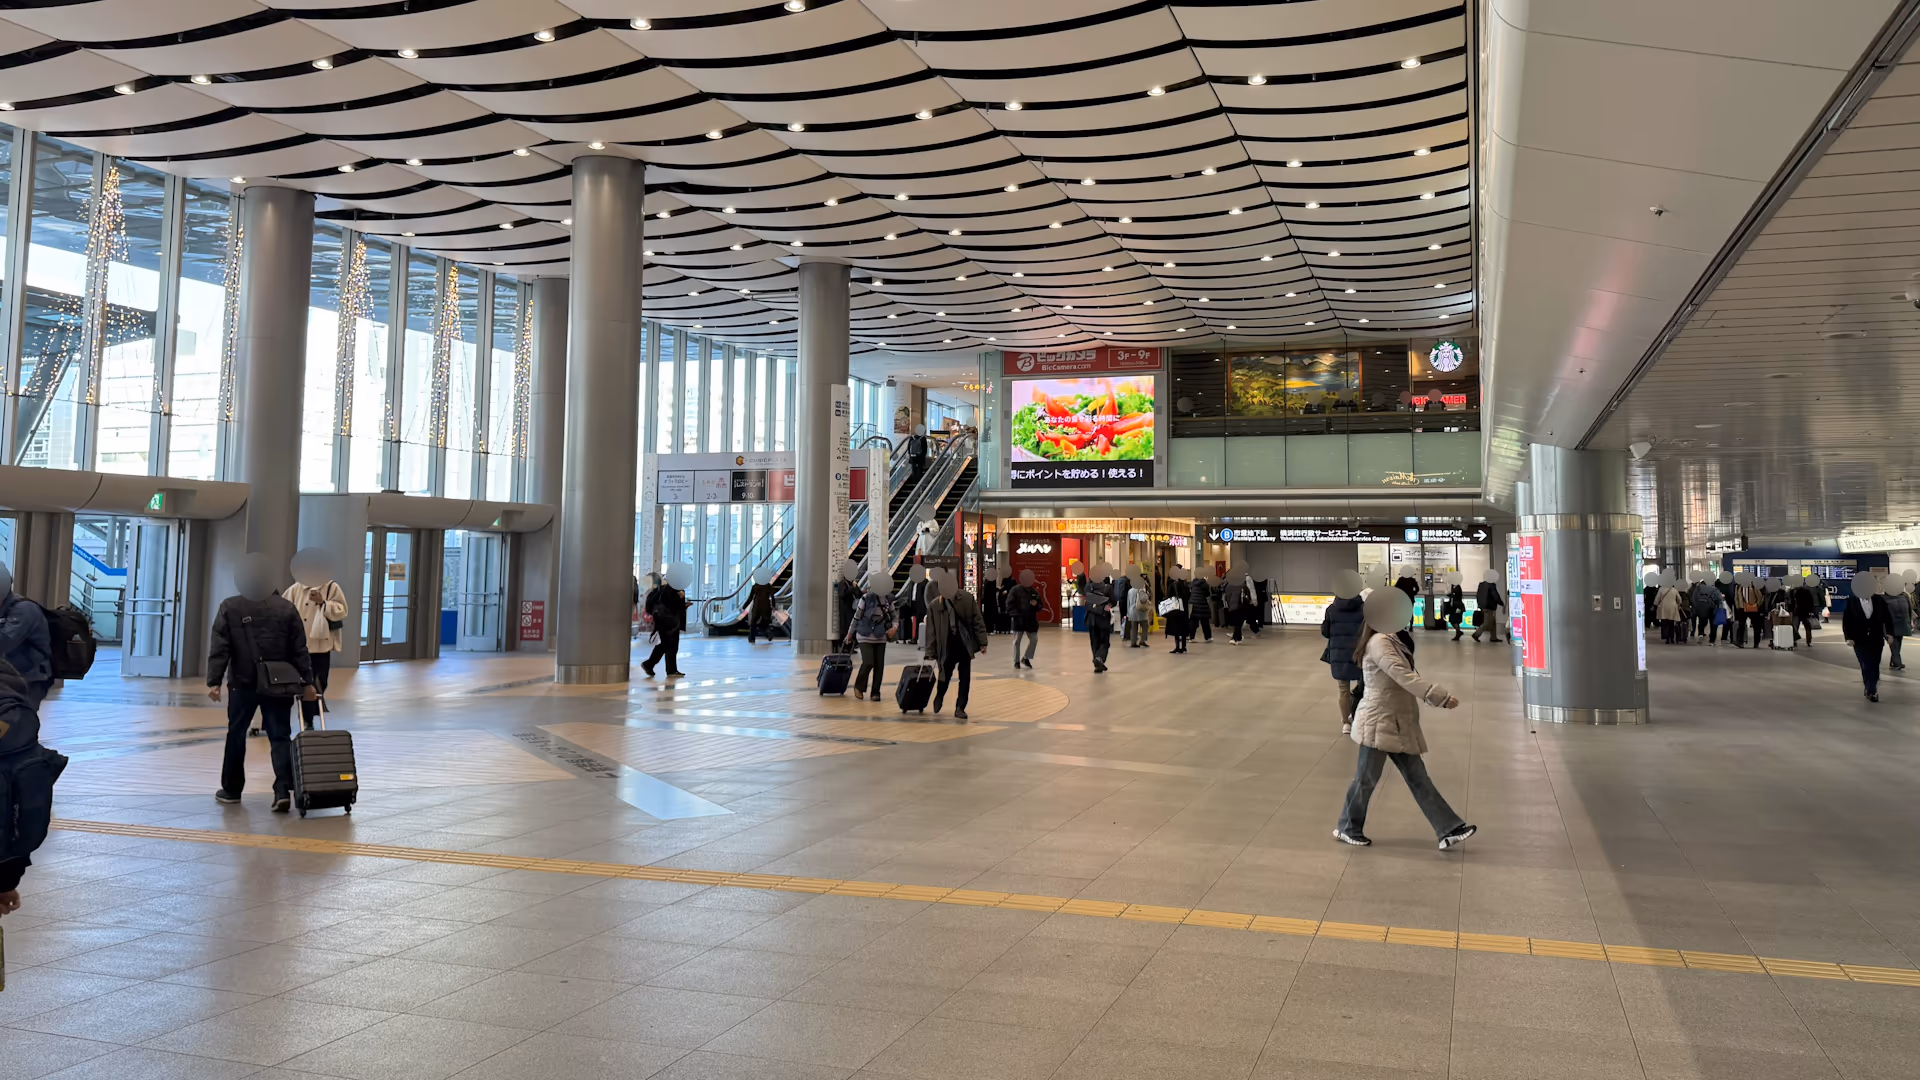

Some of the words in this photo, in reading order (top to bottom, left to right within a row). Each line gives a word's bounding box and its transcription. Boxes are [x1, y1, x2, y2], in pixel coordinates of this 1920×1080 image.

[1036, 349, 1096, 363] ビックカメラ
[1041, 362, 1092, 372] BicCamera.com
[1233, 529, 1268, 537] 市営地下鉄
[1280, 529, 1370, 537] 横浜市行政サービスコーナー
[1421, 529, 1463, 537] 新幹線のりば
